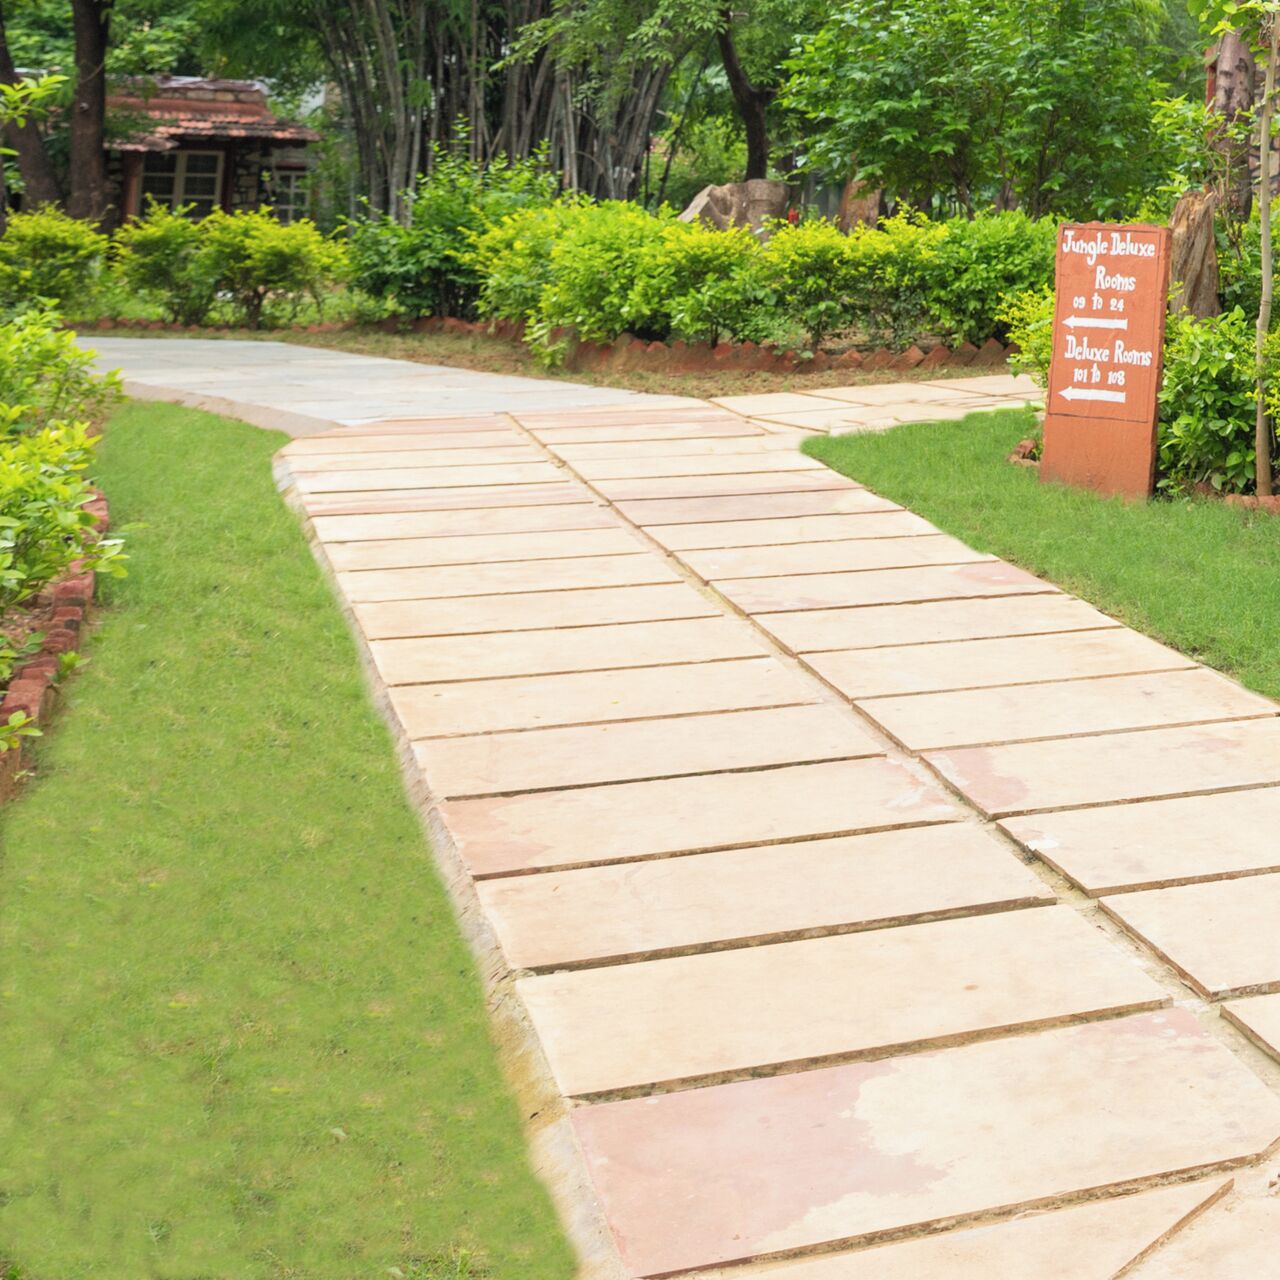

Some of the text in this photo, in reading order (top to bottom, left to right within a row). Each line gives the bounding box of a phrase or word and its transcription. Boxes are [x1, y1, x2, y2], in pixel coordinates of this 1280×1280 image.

[1061, 229, 1156, 266] Jungle Deluxe
[1094, 264, 1137, 292] Rooms
[1072, 292, 1125, 313] 09 to 24
[1063, 334, 1153, 367] Deluxe Rooms
[1072, 362, 1126, 386] 101 to 108
